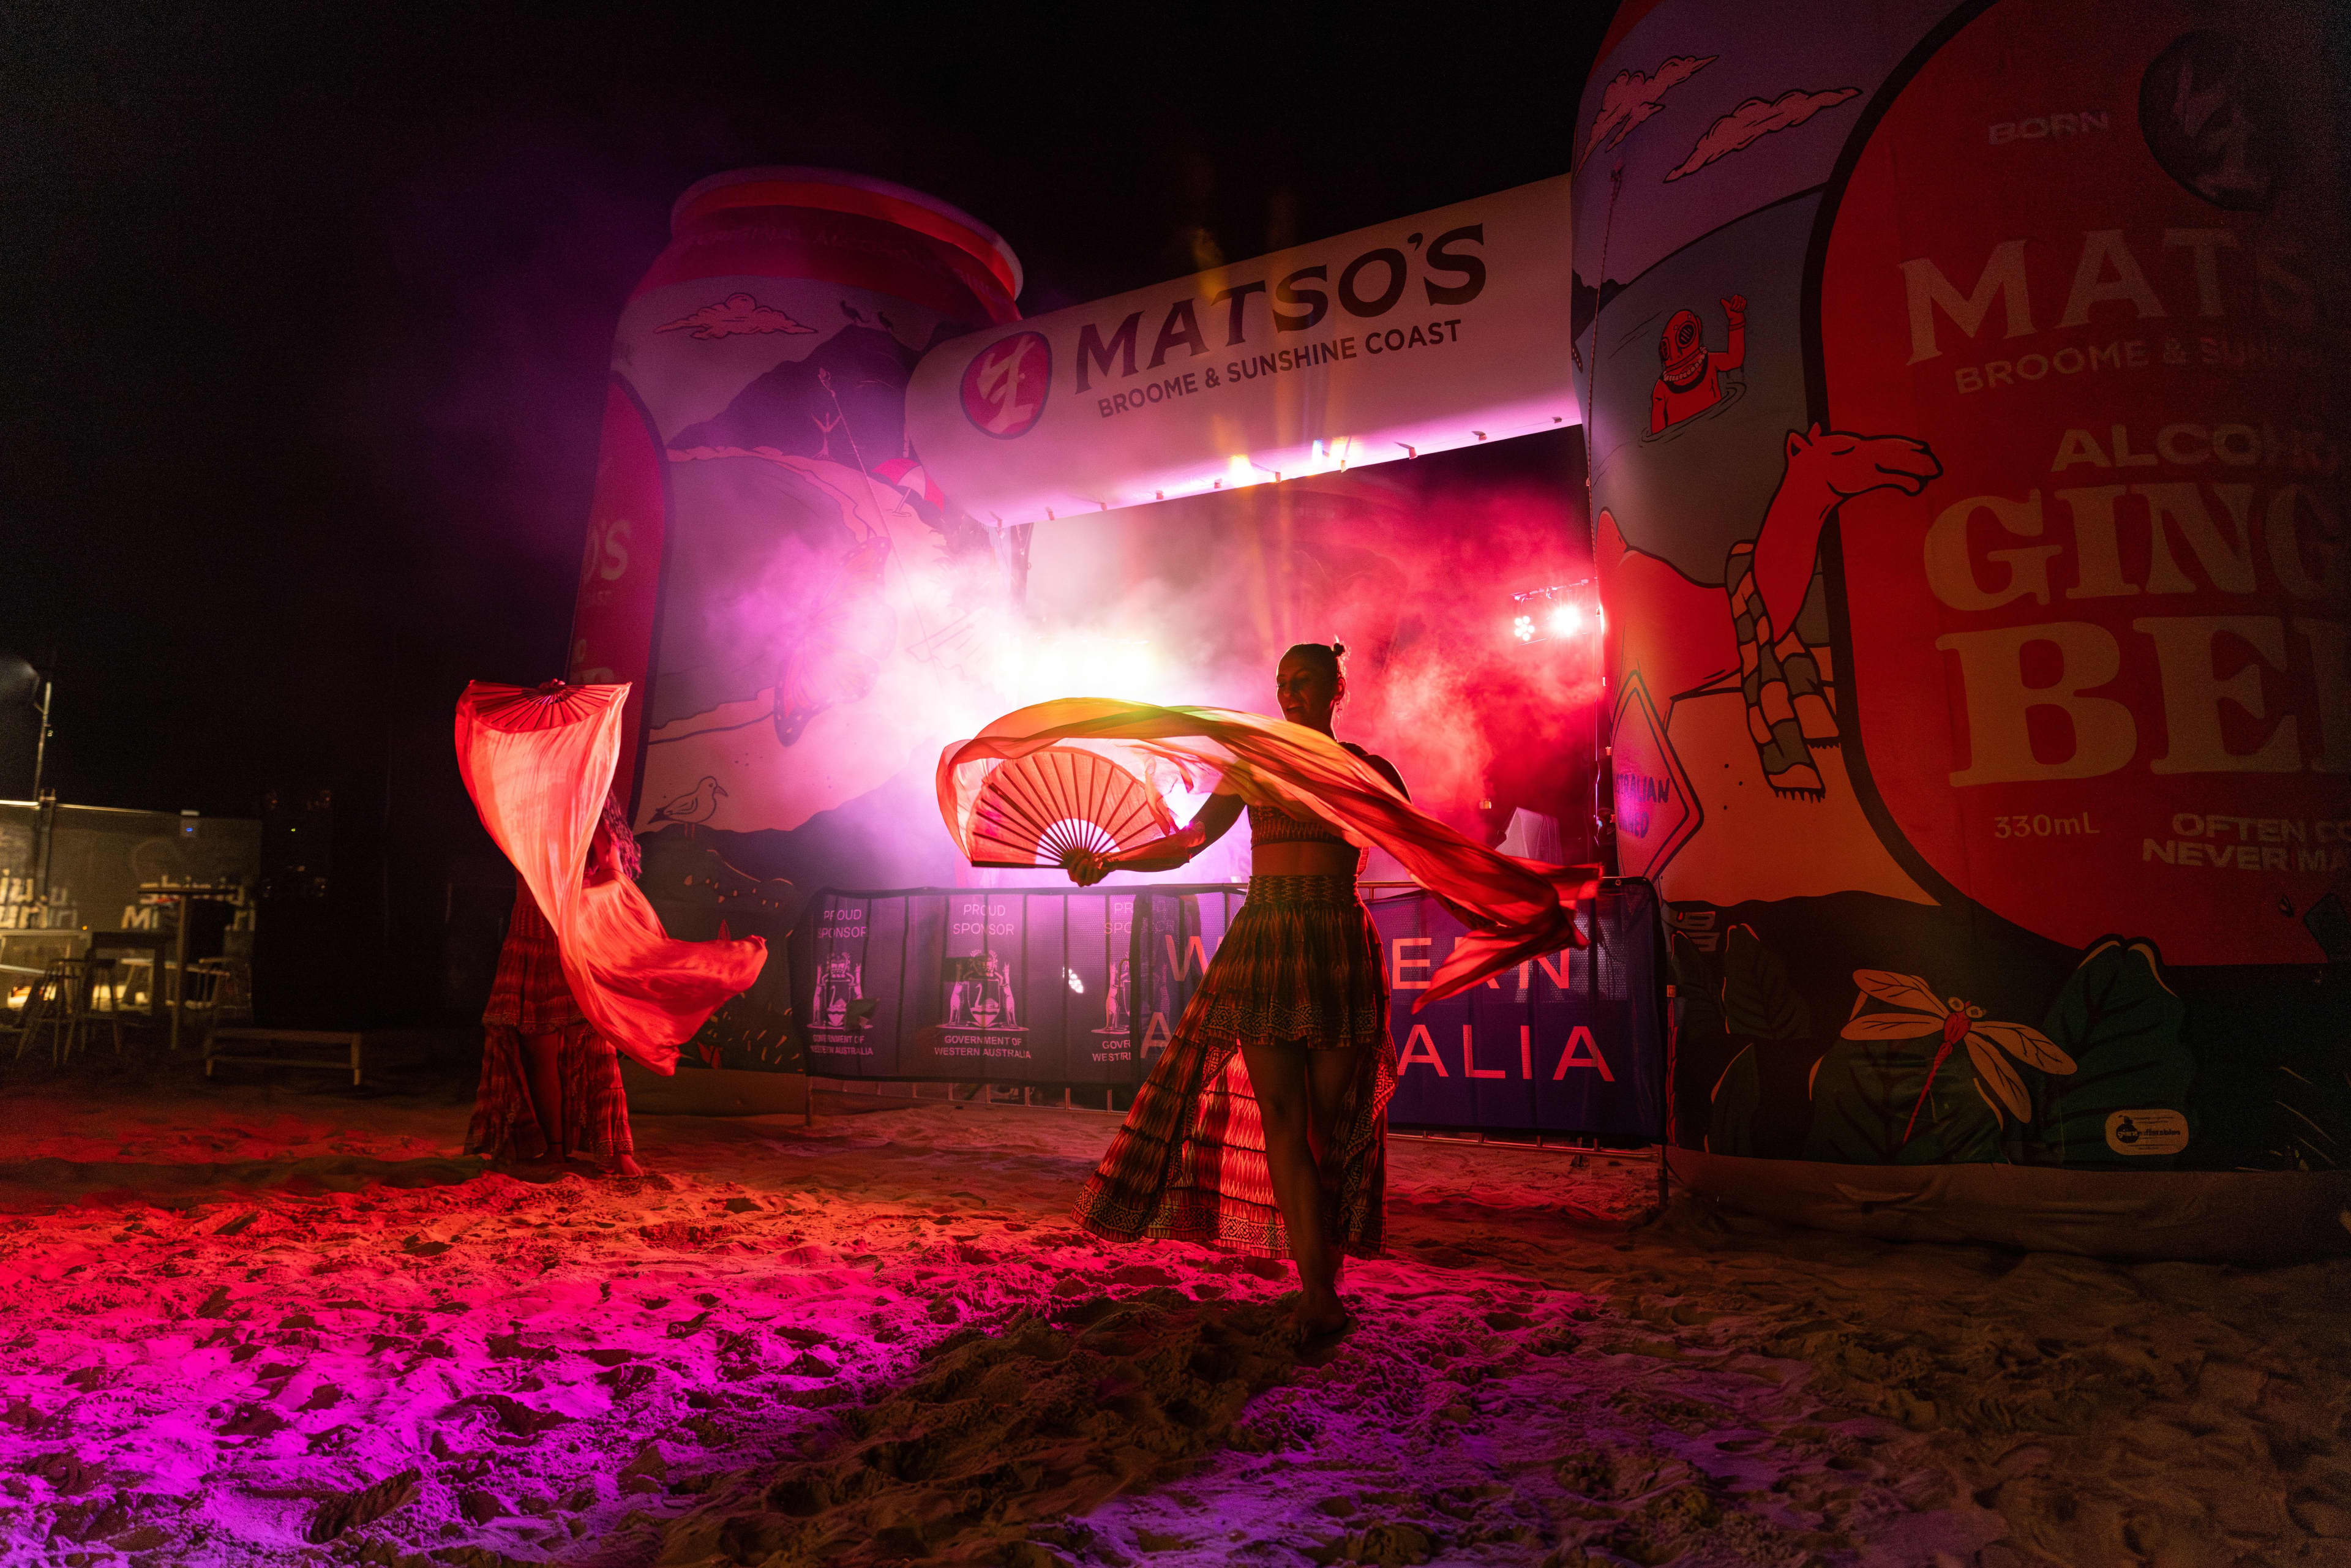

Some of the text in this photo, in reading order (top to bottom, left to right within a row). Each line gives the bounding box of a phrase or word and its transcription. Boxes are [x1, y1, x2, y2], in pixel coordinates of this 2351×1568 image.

[1989, 110, 2110, 144] BORN
[1074, 224, 1487, 393] MATSO'S
[1098, 319, 1462, 418] BROOME & SUNSHINE COAST
[1955, 337, 2149, 395] BROOME
[1993, 810, 2100, 838] 330mL
[2172, 812, 2307, 842] OFTEN
[2142, 837, 2290, 871] NEVER
[964, 904, 1006, 917] PROUD
[953, 923, 1014, 936] SPONSOR
[835, 1046, 874, 1056] AUSTRALIA
[934, 1047, 1032, 1059] WESTERN AUSTRALIA
[945, 1035, 1022, 1046] GOVERNMENT OF
